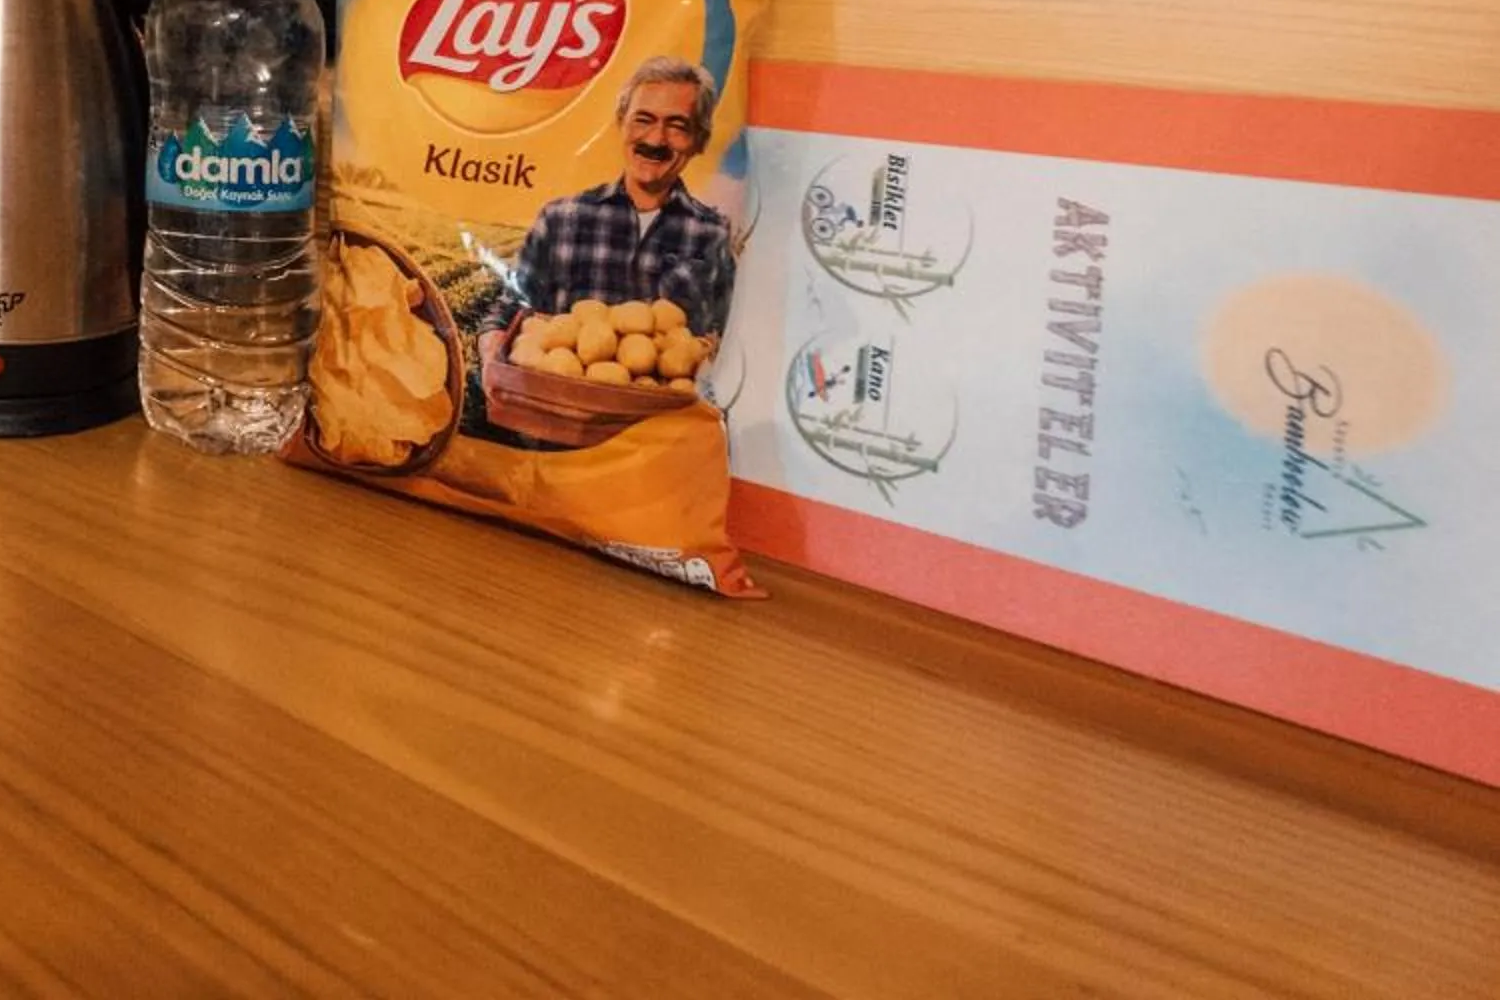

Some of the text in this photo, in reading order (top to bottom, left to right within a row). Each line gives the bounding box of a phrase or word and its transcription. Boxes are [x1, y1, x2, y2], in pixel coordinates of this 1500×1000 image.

[175, 145, 303, 185] damla
[423, 143, 537, 189] Klasik
[883, 154, 906, 231] Bisiklet
[867, 345, 889, 403] Kano
